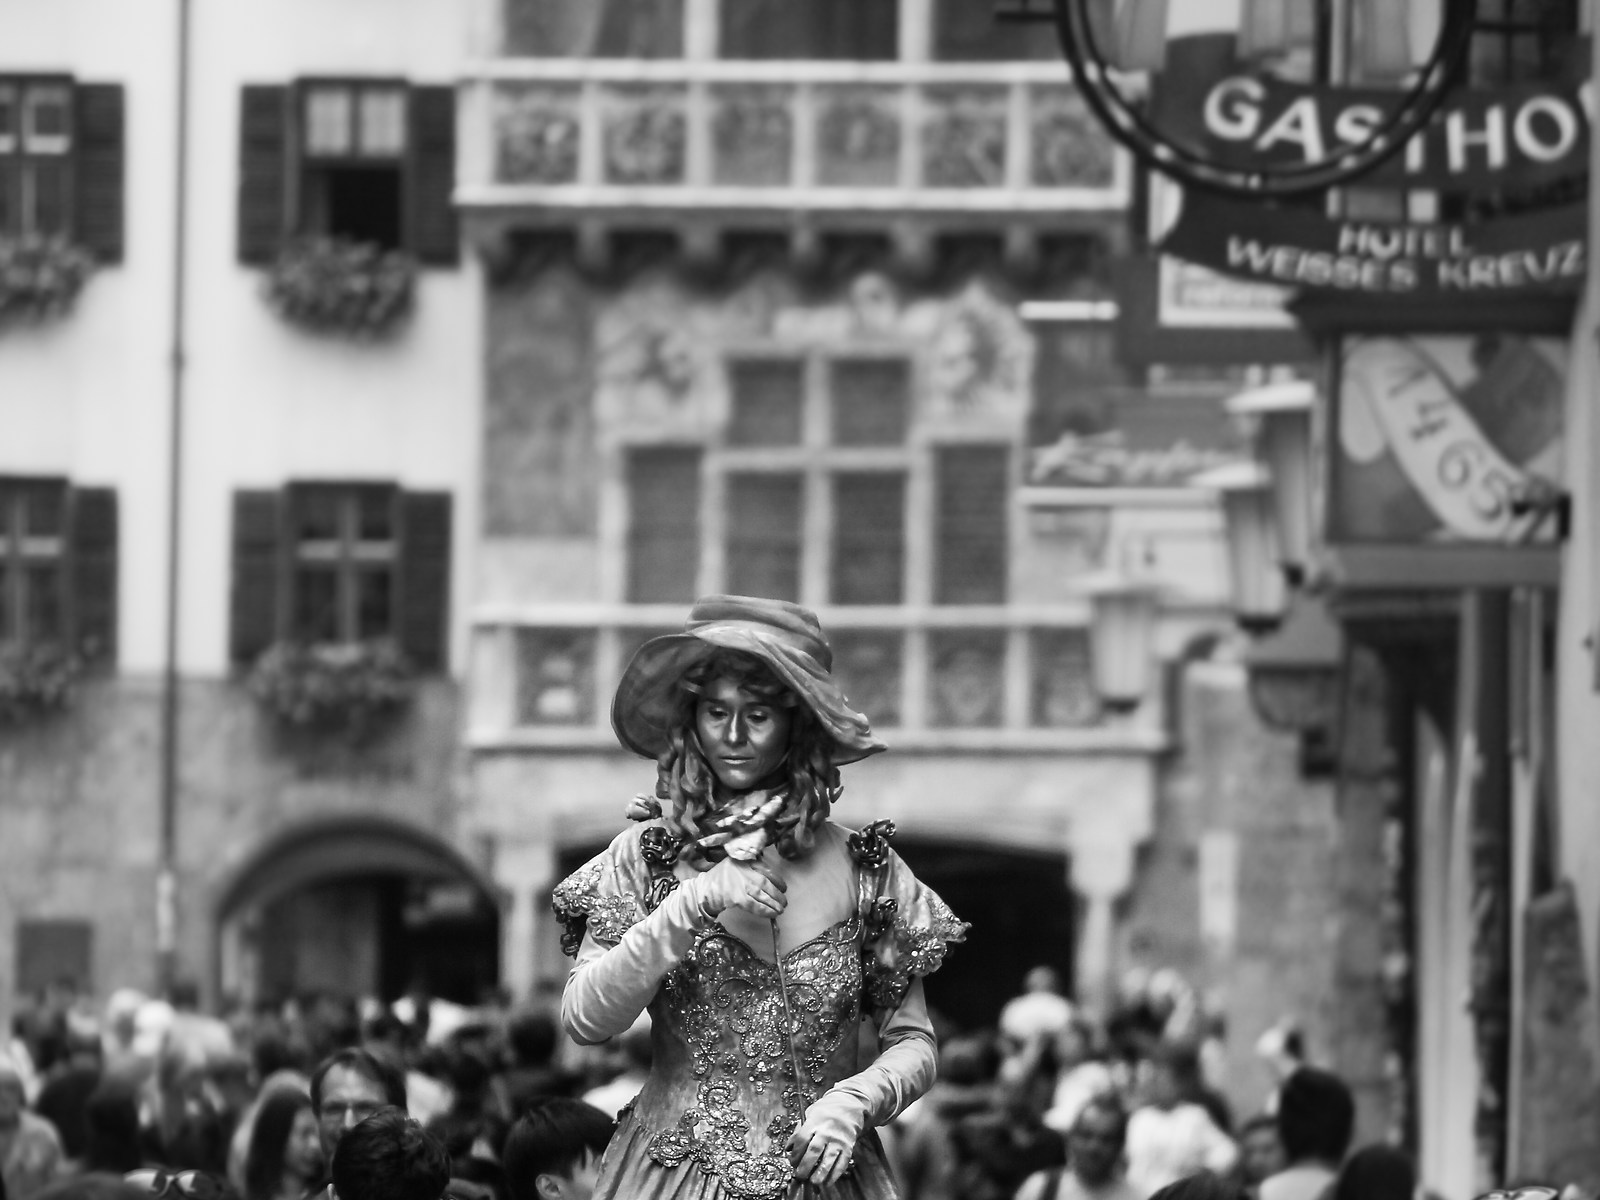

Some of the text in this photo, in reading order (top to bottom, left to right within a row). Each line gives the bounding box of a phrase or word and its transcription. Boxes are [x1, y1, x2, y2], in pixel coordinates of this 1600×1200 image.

[1203, 76, 1593, 174] GASHO
[1226, 234, 1418, 292] WEISSES
[1337, 223, 1472, 260] HOTEL
